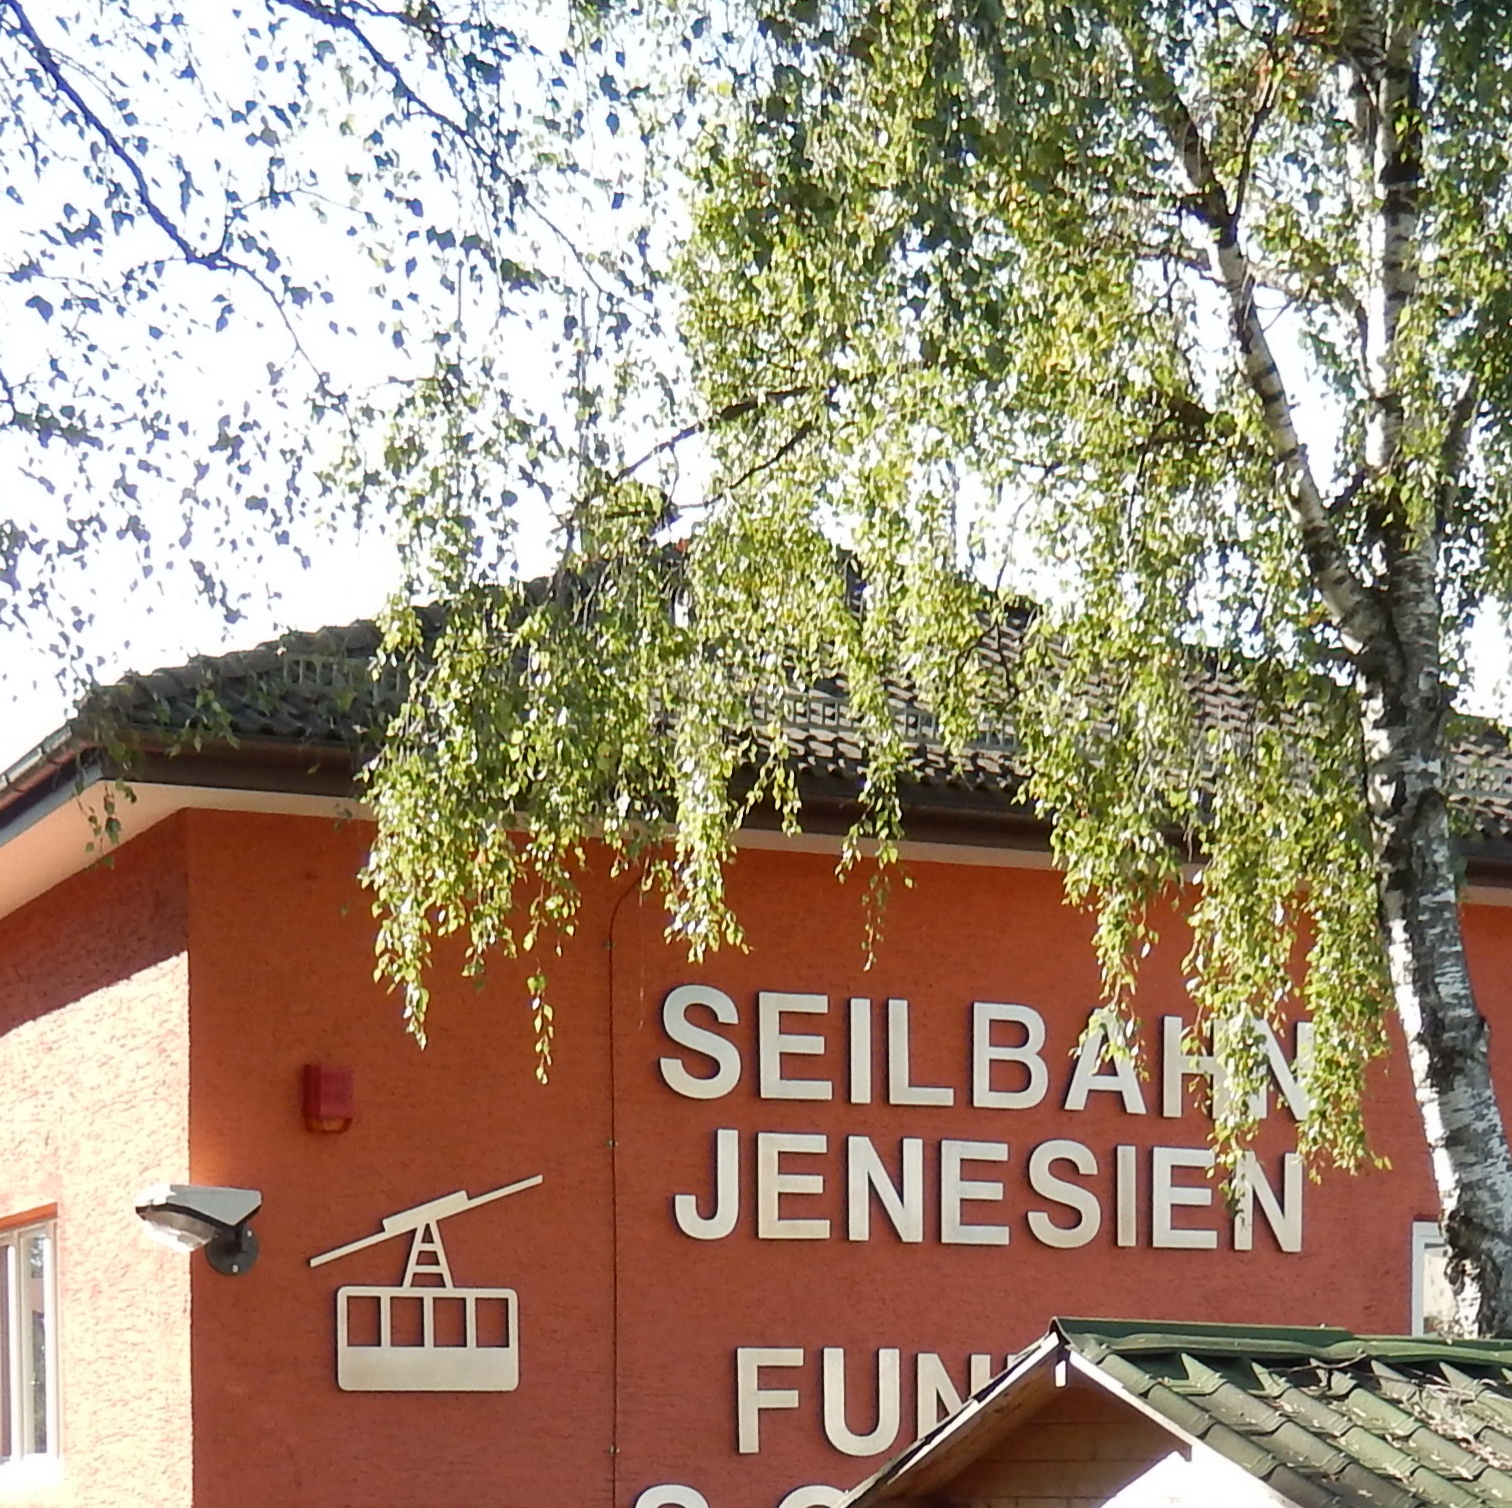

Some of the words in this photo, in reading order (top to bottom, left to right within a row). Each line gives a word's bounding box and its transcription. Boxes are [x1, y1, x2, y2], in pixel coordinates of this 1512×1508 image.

[660, 985, 1315, 1121] SEILBAHN
[674, 1129, 1302, 1252] JENESIEN
[737, 1347, 1025, 1456] FUN
